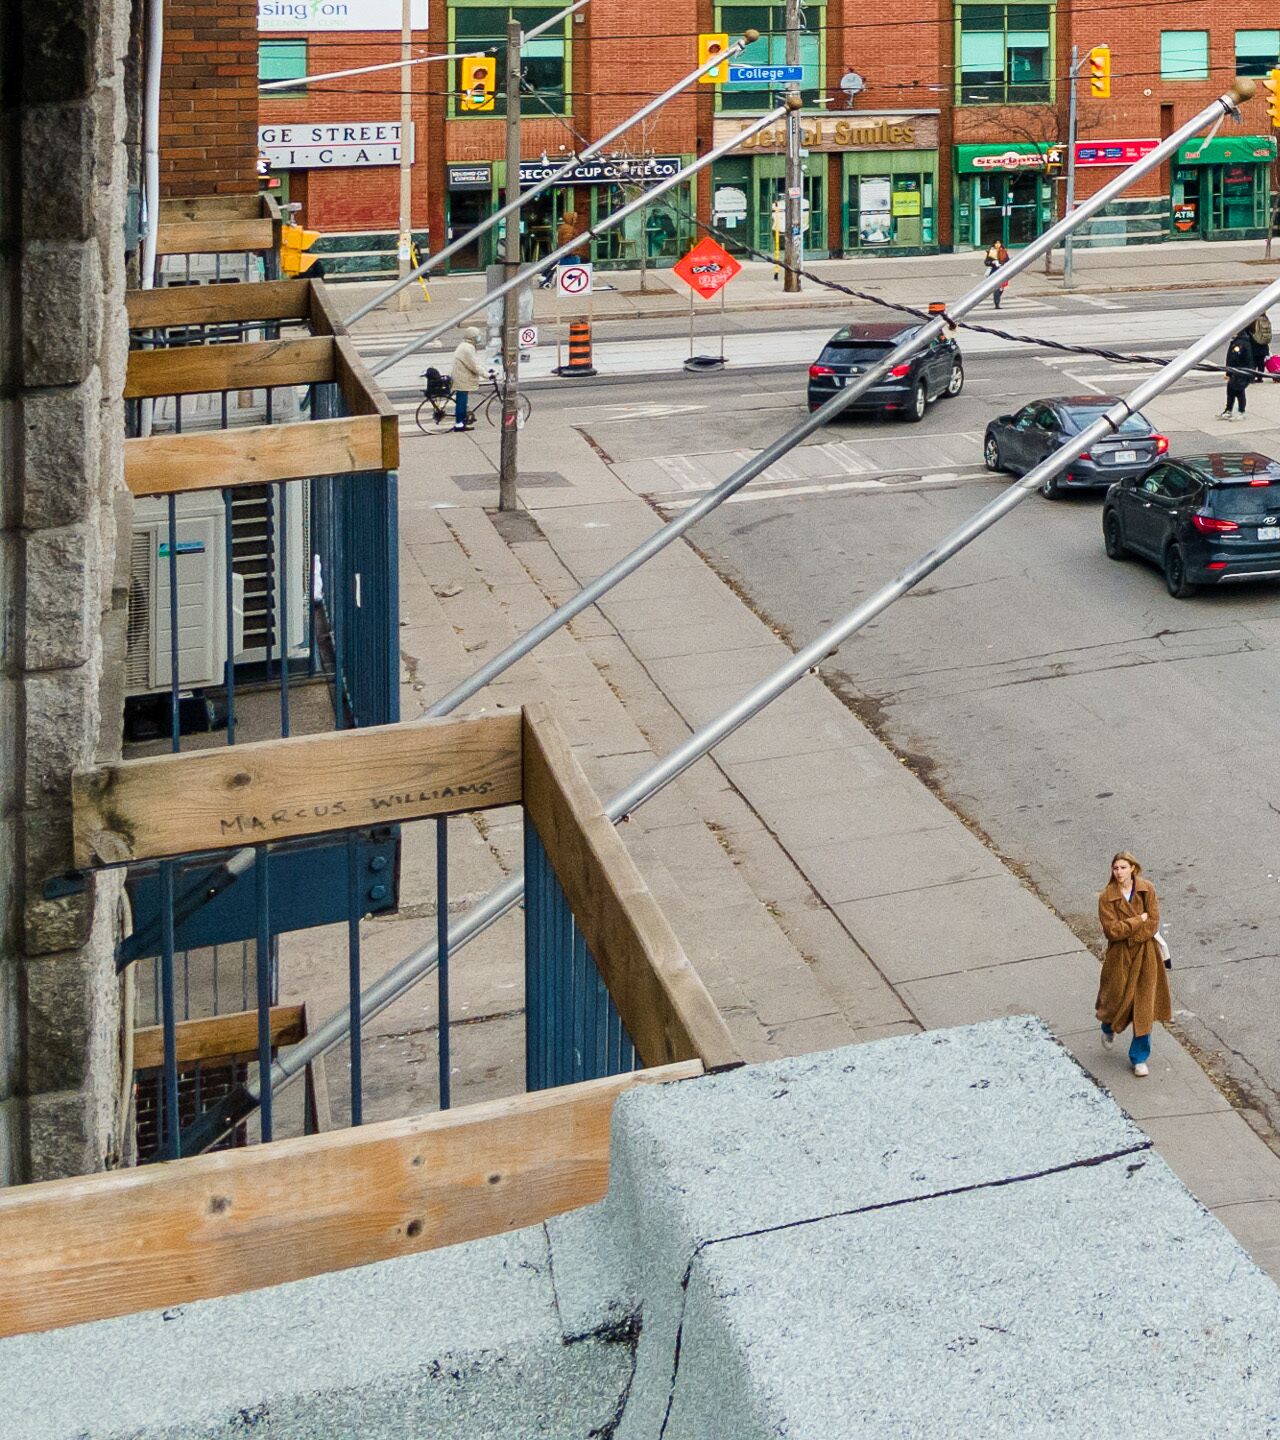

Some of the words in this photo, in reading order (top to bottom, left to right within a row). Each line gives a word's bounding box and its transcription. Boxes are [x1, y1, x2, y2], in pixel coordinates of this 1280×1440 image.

[738, 68, 784, 79] College
[311, 126, 402, 142] STREET
[741, 121, 822, 148] Denal
[834, 120, 915, 145] Smiles
[574, 166, 602, 178] CUP
[1174, 210, 1195, 219] ATM
[219, 800, 348, 836] MARCUS
